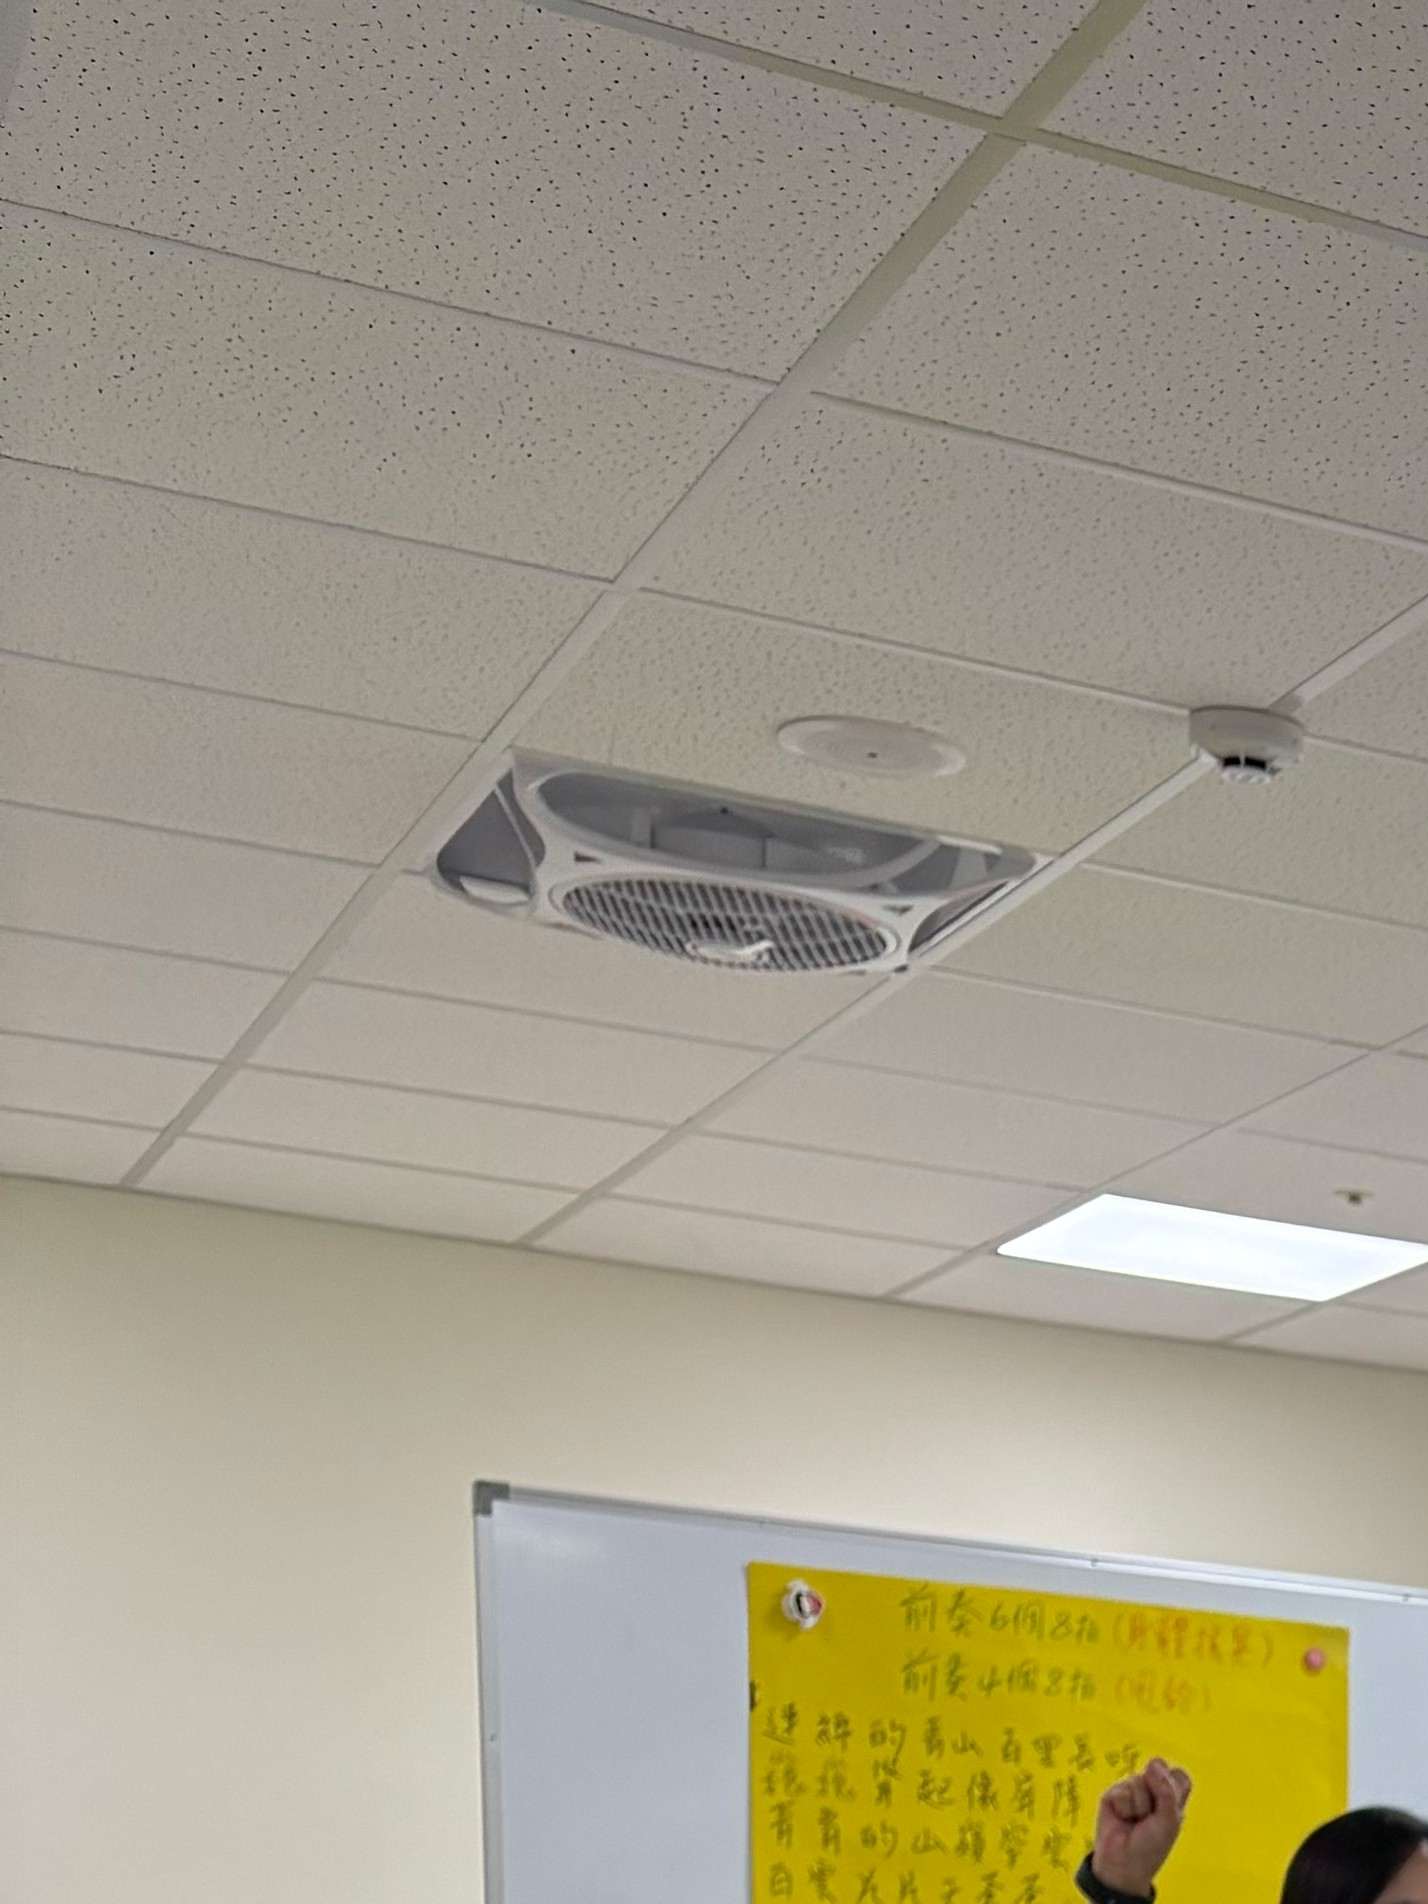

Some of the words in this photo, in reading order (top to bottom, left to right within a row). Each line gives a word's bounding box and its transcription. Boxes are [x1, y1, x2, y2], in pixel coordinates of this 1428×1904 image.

[768, 1799, 1095, 1873] 青青的山嶺穿雲
